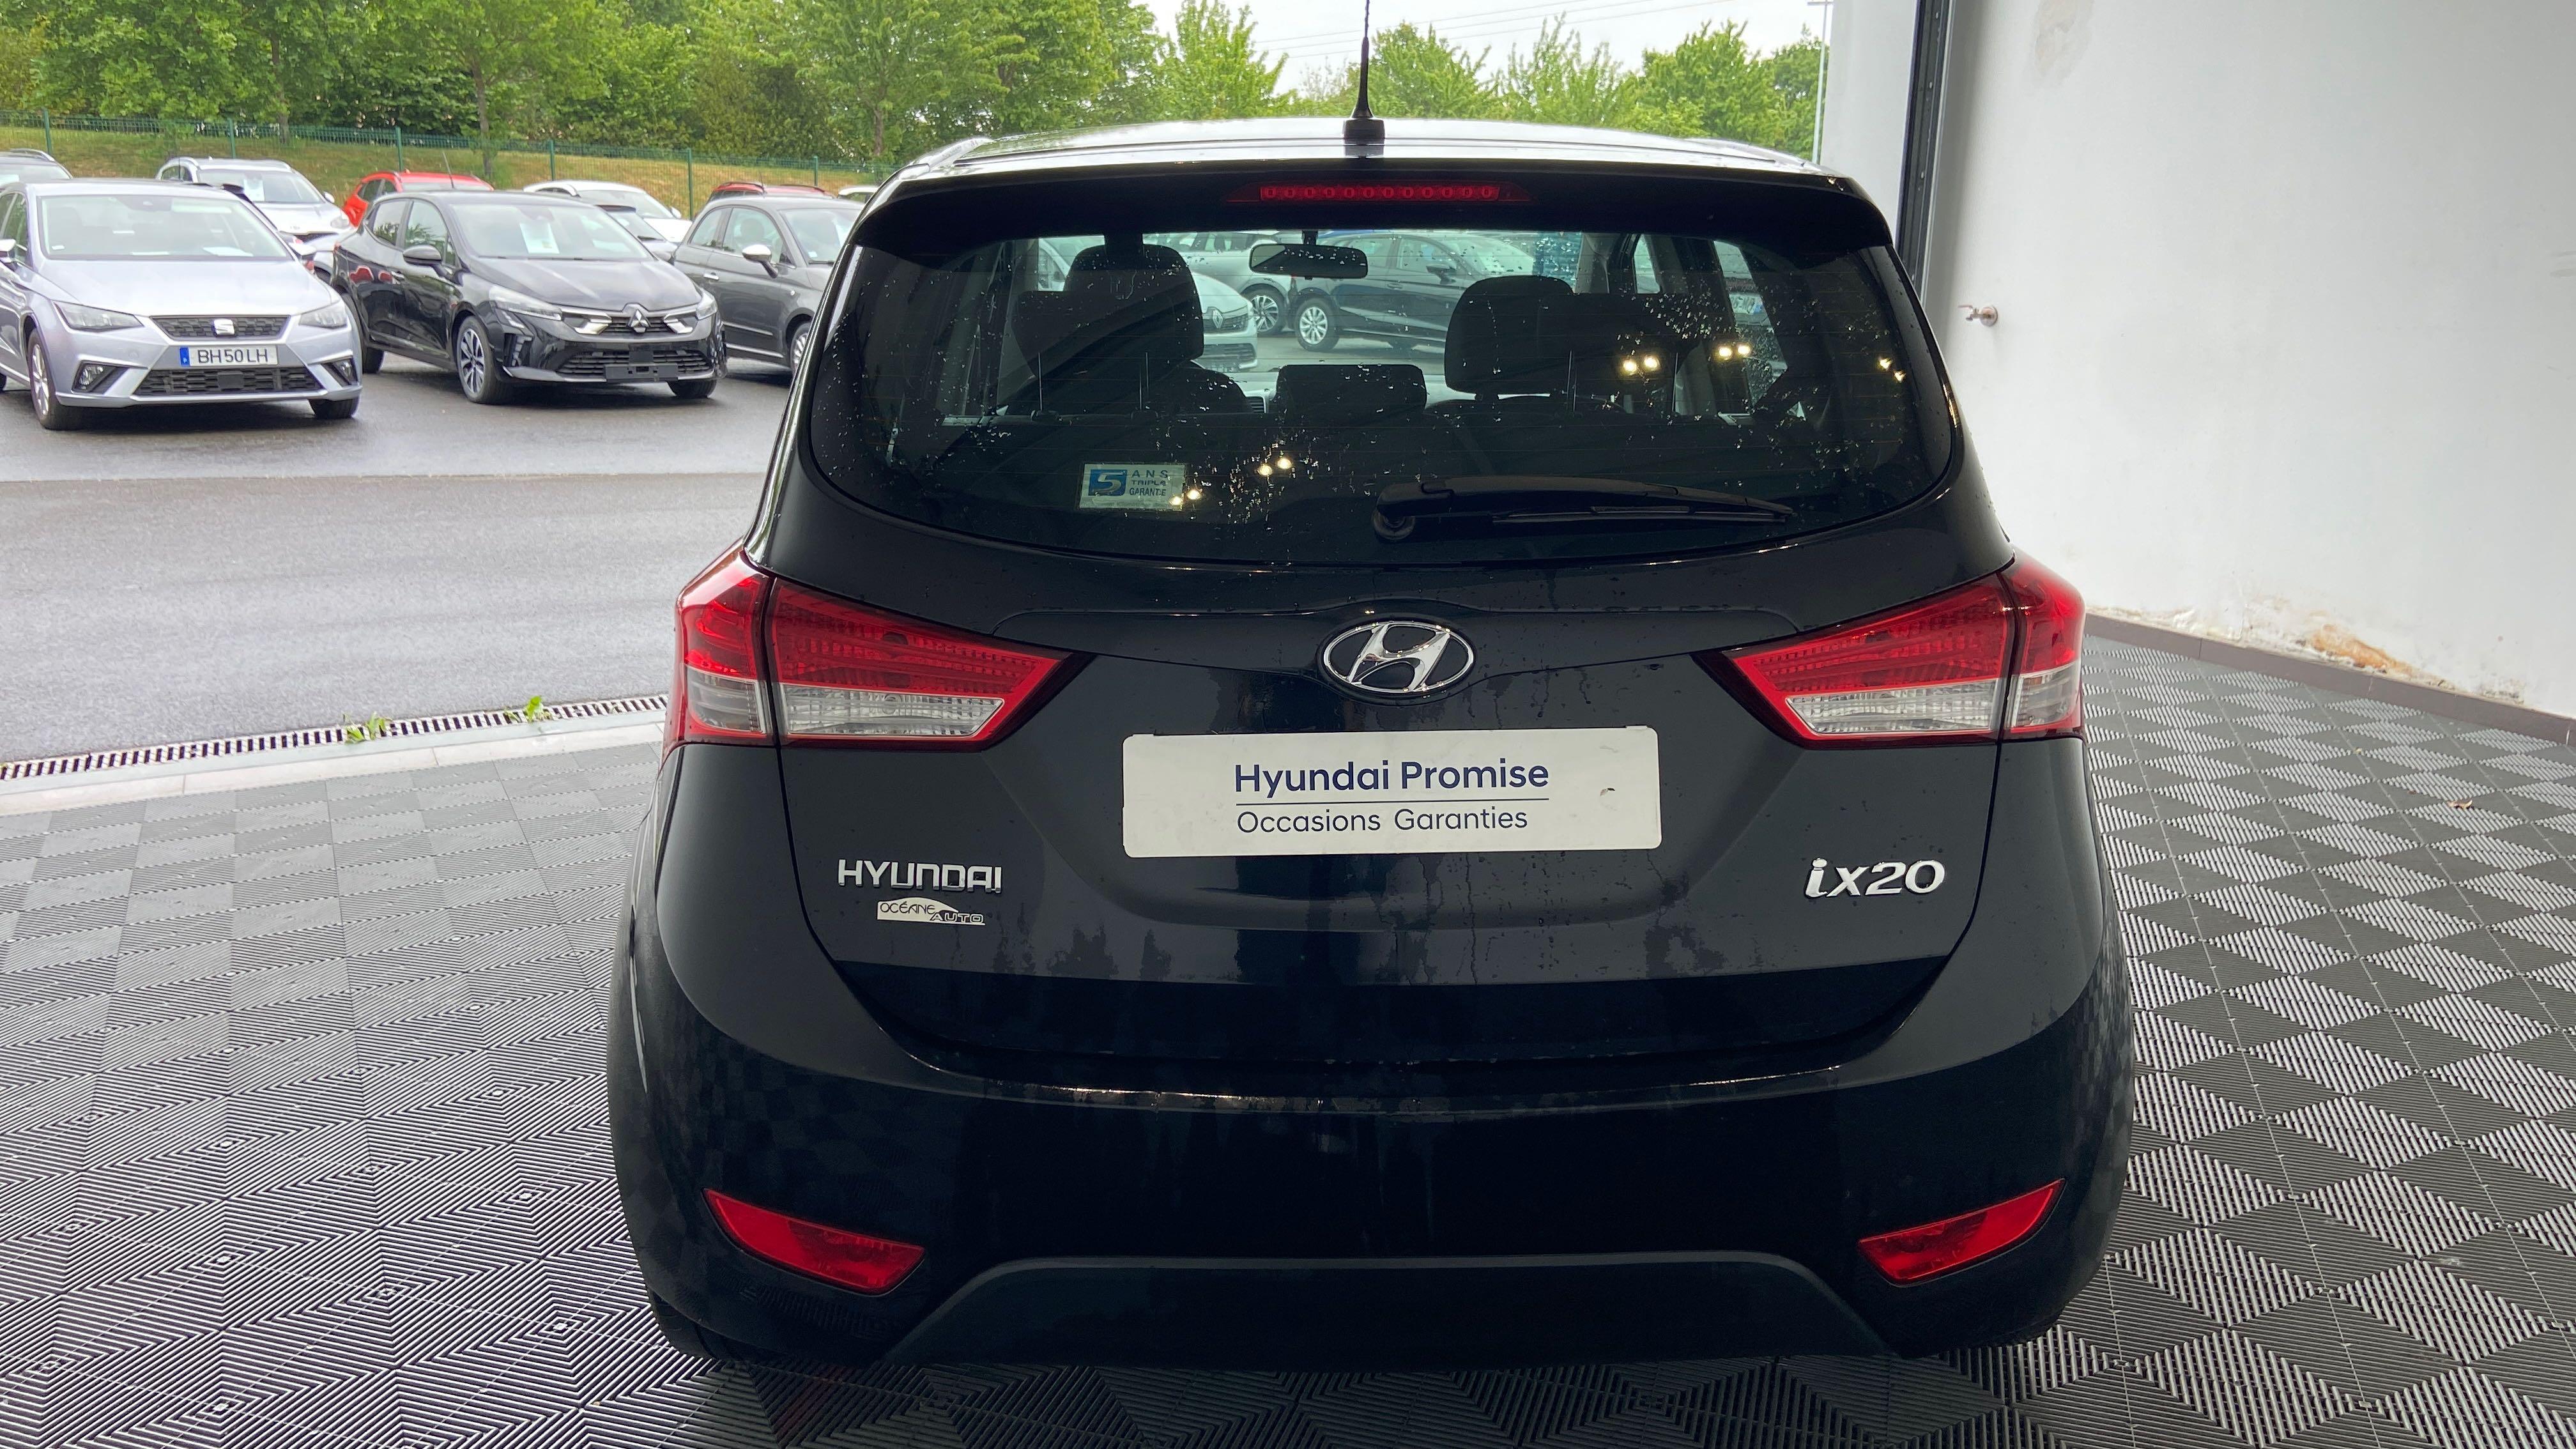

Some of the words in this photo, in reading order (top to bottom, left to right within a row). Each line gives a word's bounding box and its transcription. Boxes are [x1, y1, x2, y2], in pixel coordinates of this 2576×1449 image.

[1235, 760, 1389, 799] Hyundai
[1401, 758, 1549, 789] Promise
[1237, 809, 1381, 833] Occasions
[1394, 806, 1528, 831] Garanties
[838, 859, 1002, 894] HYUNDAI
[1805, 857, 1945, 898] ix20
[880, 900, 936, 915] OCÉANE
[930, 912, 984, 924] AUTO
